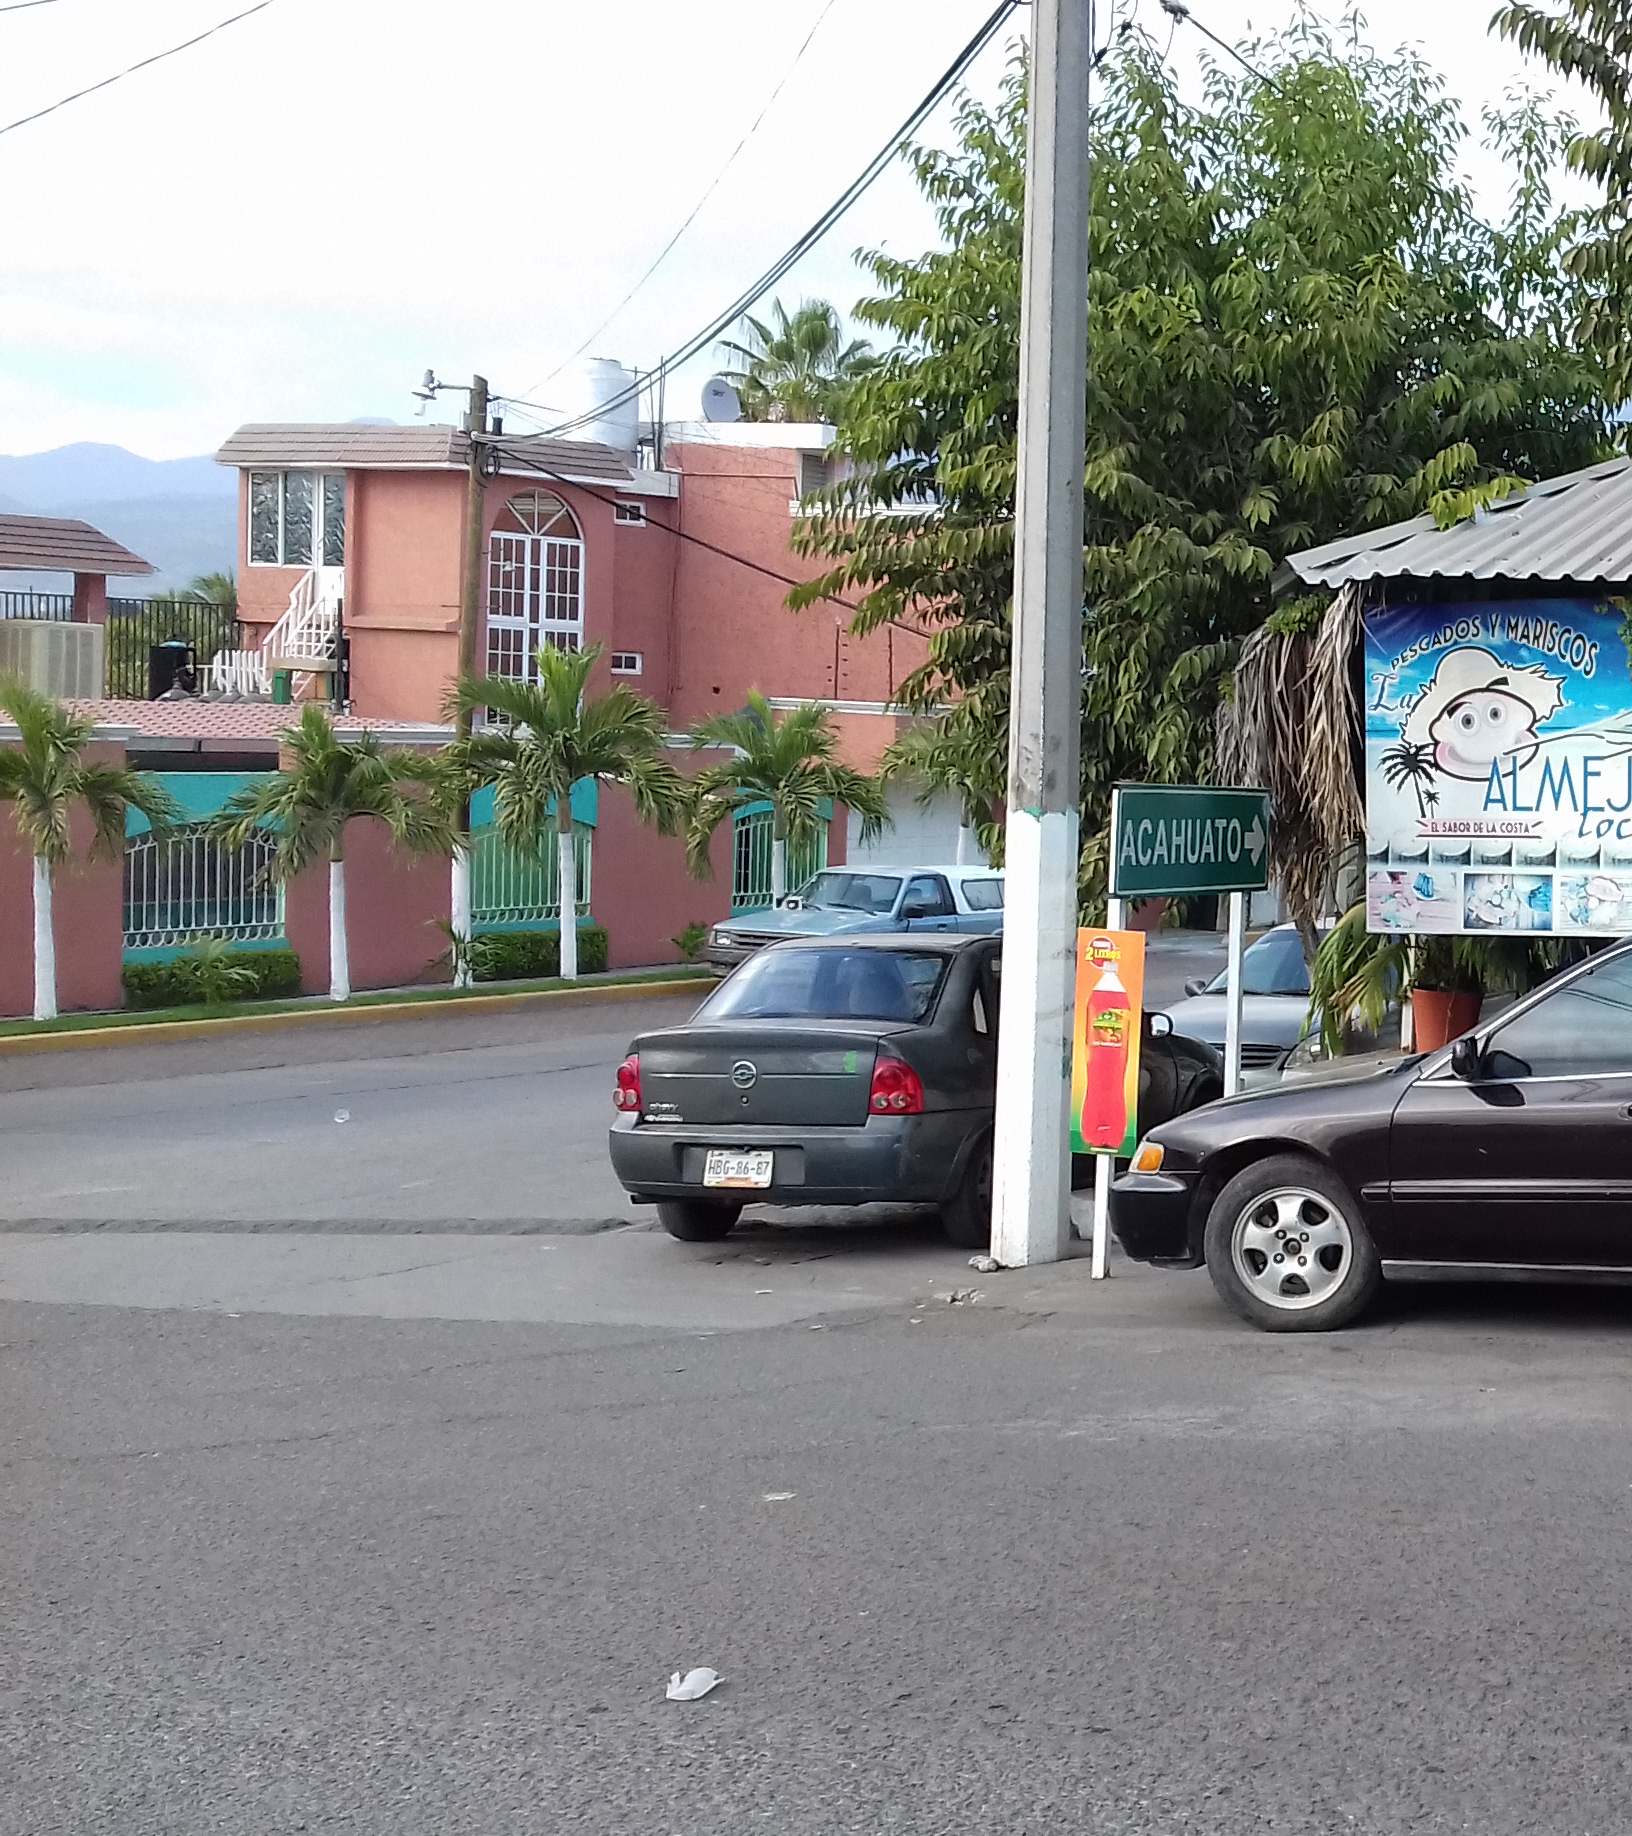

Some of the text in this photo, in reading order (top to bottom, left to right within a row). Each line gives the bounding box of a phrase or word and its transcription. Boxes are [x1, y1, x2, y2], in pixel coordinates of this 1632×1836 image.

[1391, 613, 1599, 678] PESCADOS Y MARISCOS
[1120, 818, 1241, 866] ACAHUATO
[1431, 822, 1530, 833] EL SABOR DE LA COSTA
[1085, 947, 1094, 961] 2
